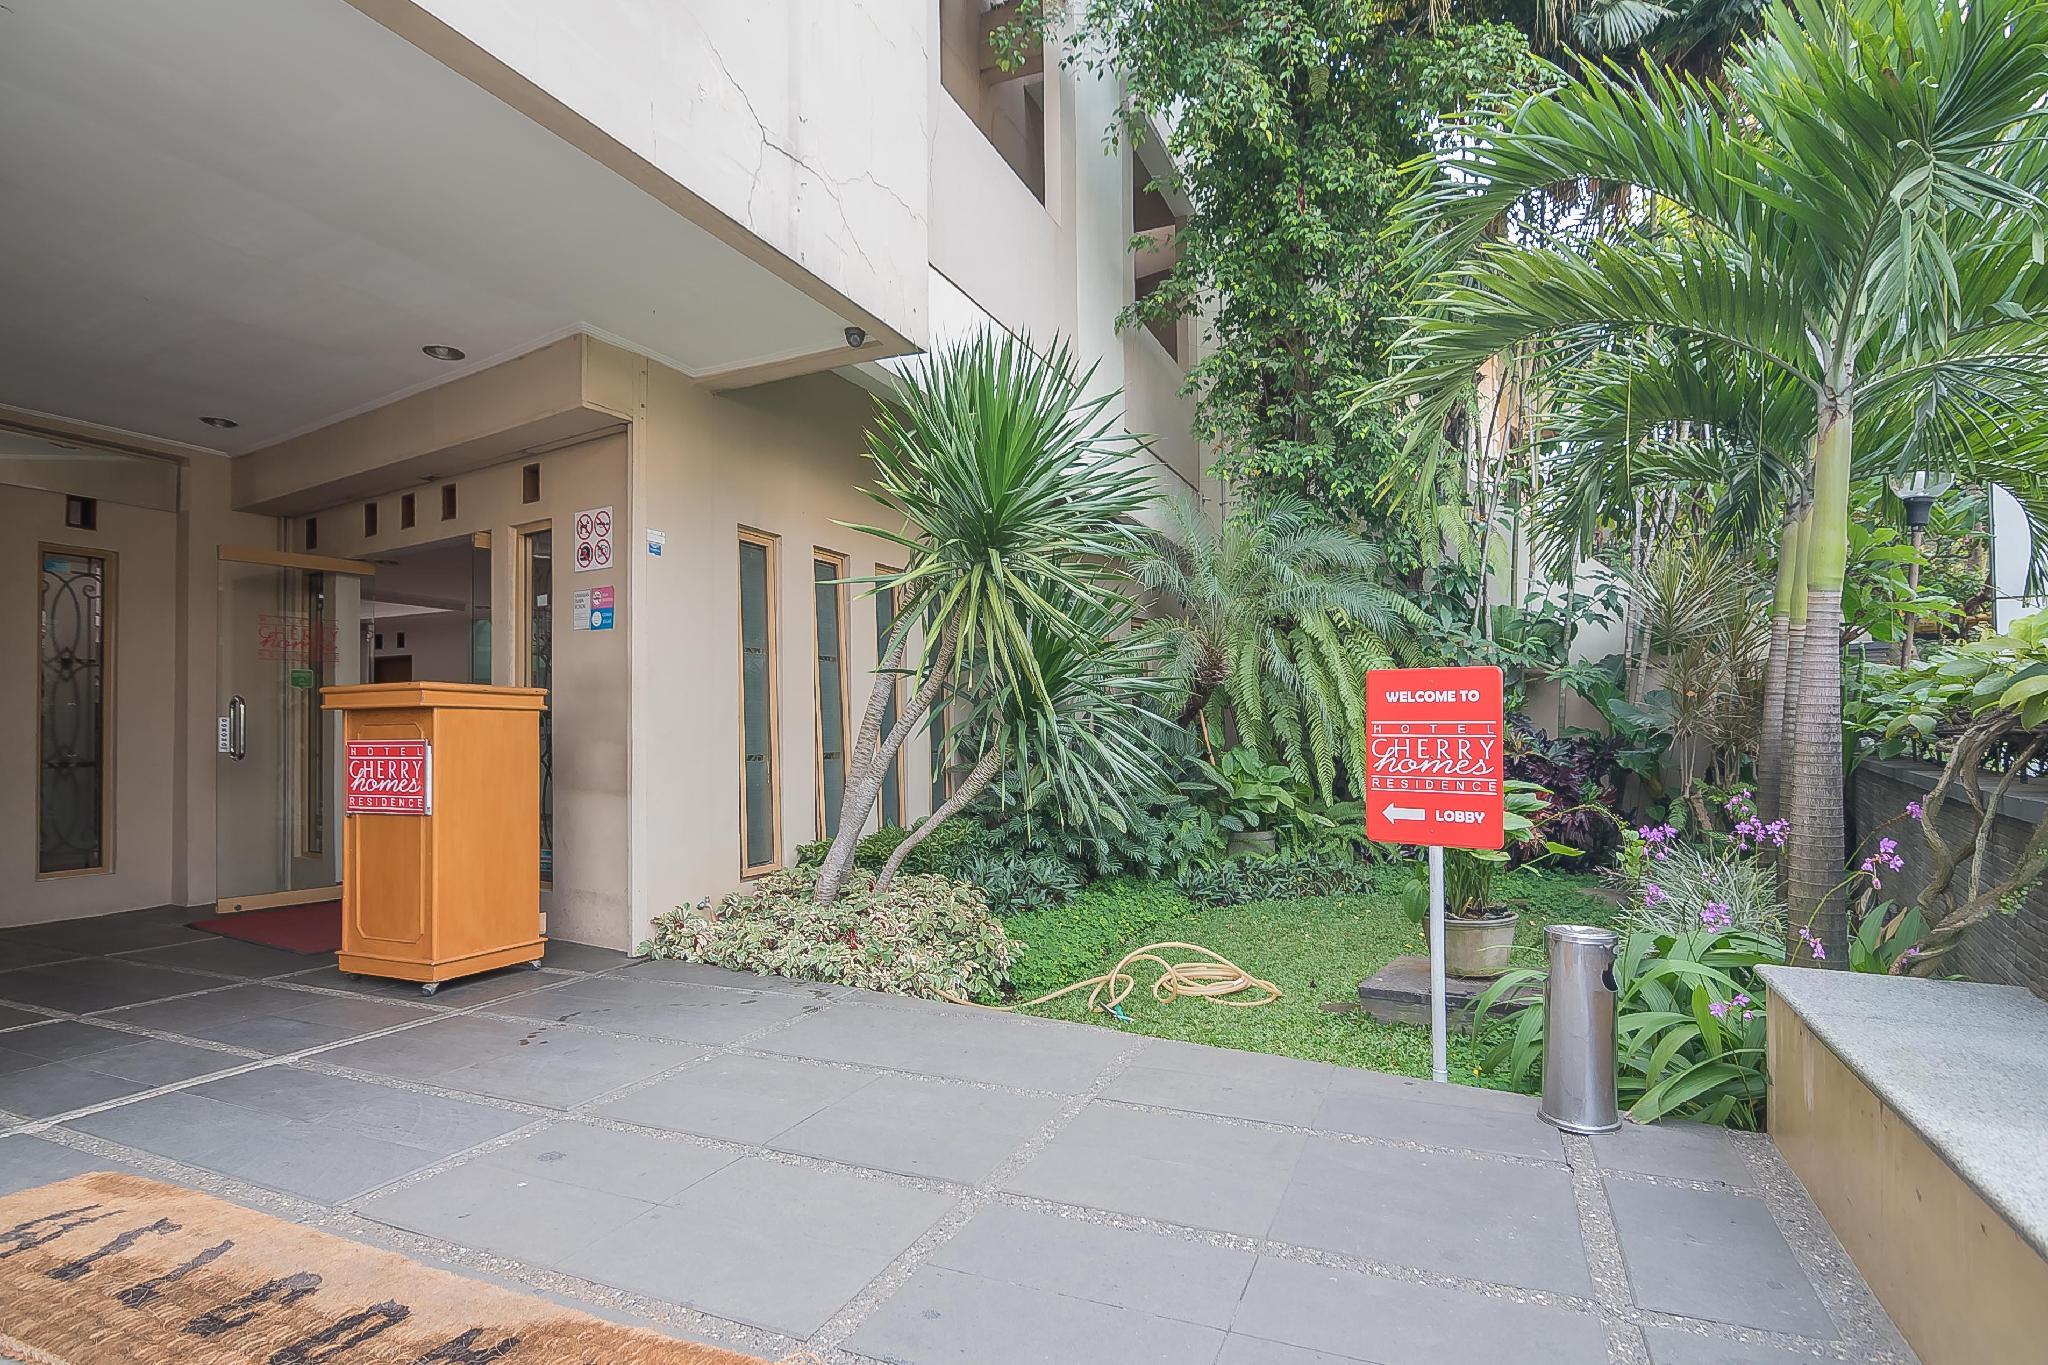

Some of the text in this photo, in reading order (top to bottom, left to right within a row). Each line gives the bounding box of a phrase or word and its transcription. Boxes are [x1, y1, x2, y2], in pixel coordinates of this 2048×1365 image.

[1385, 690, 1480, 703] WELCOME TO
[1373, 724, 1495, 735] HOTEL
[350, 747, 423, 756] HOTEL
[1371, 738, 1495, 760] CHERRY
[1373, 747, 1495, 775] homes
[349, 760, 423, 779] CHERRY
[350, 768, 421, 793] homes
[1372, 778, 1497, 791] RESIDENCE
[349, 797, 424, 808] RESIDENCE
[1435, 810, 1486, 824] LOBBY
